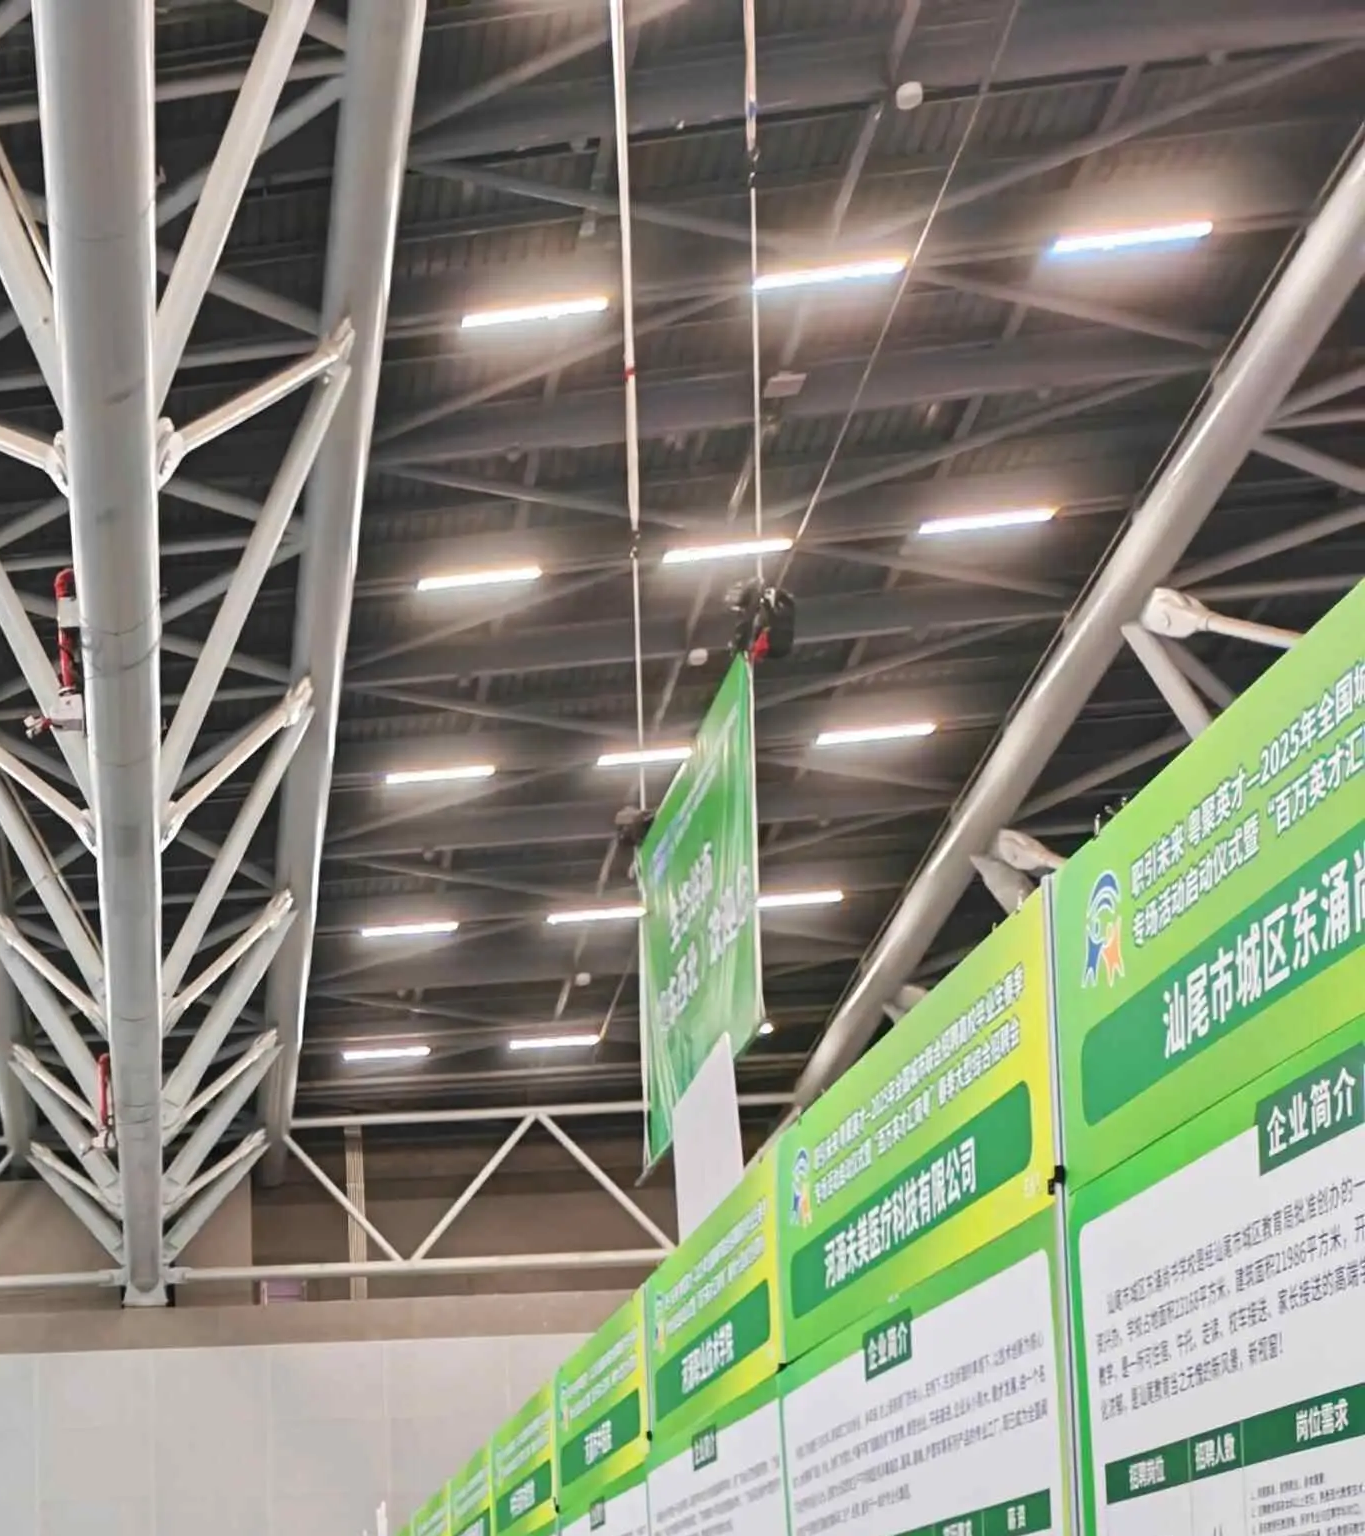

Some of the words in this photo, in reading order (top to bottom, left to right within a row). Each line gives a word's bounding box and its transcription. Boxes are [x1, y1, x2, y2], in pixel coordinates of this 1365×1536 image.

[1130, 822, 1185, 898] 职引未来
[1267, 1067, 1356, 1157] 企业简介
